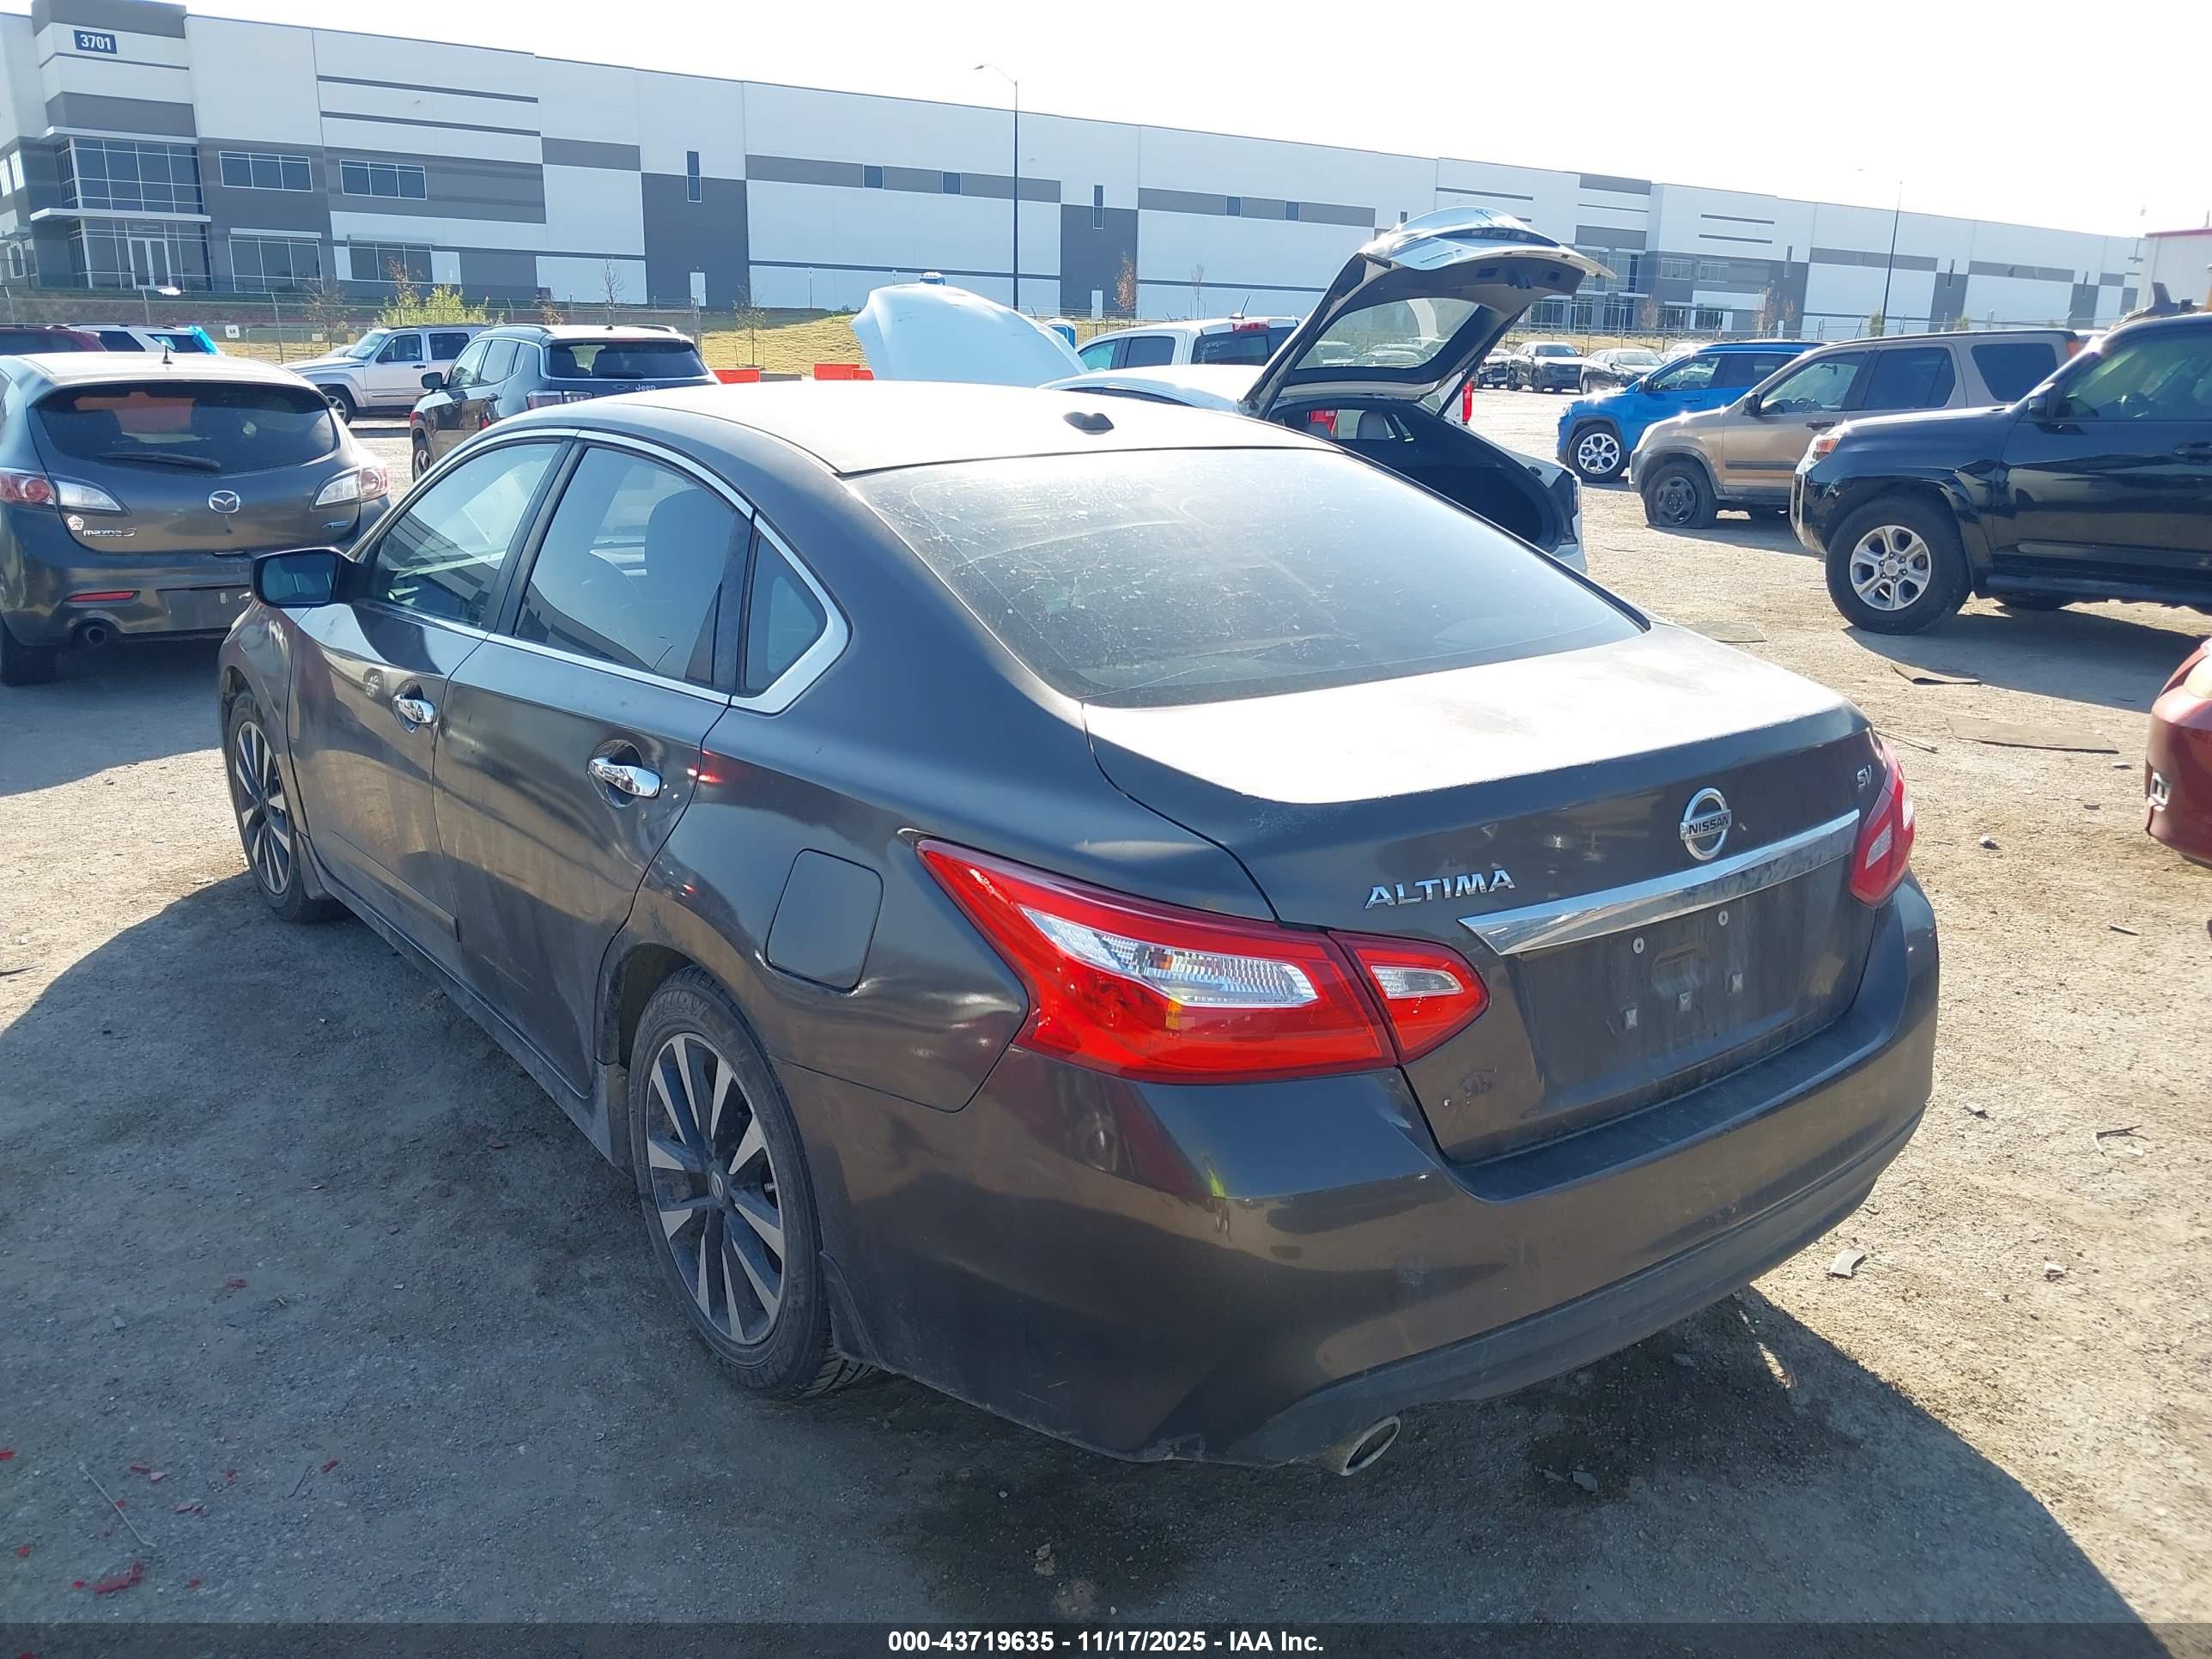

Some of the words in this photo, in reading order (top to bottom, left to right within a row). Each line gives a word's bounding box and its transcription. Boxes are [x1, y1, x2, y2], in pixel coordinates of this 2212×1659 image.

[79, 33, 112, 51] 3701
[635, 383, 656, 392] Jeep
[1856, 764, 1872, 789] SV
[1688, 816, 1729, 836] NISSAN
[1364, 868, 1516, 909] ALTIMA
